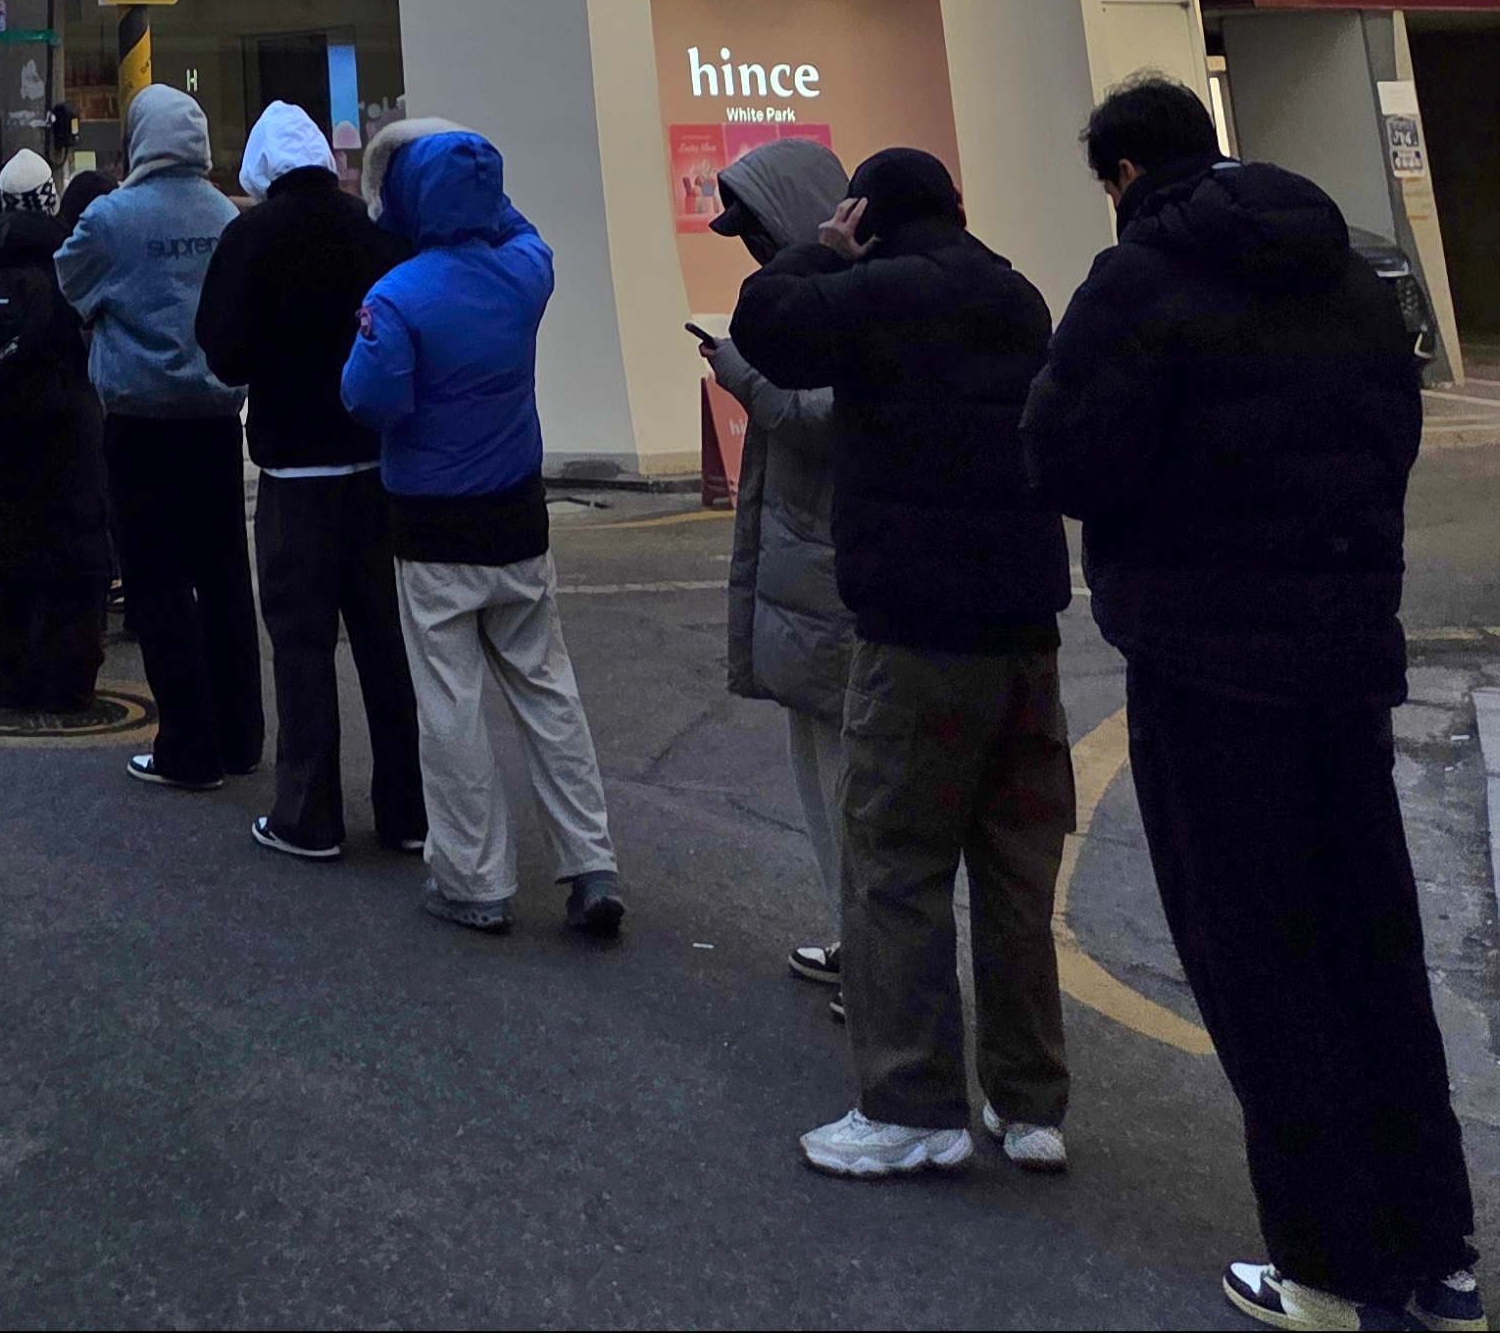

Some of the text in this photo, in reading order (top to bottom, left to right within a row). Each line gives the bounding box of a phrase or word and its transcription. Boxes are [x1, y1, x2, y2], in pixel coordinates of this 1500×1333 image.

[687, 46, 821, 98] hince
[726, 106, 796, 123] White Park
